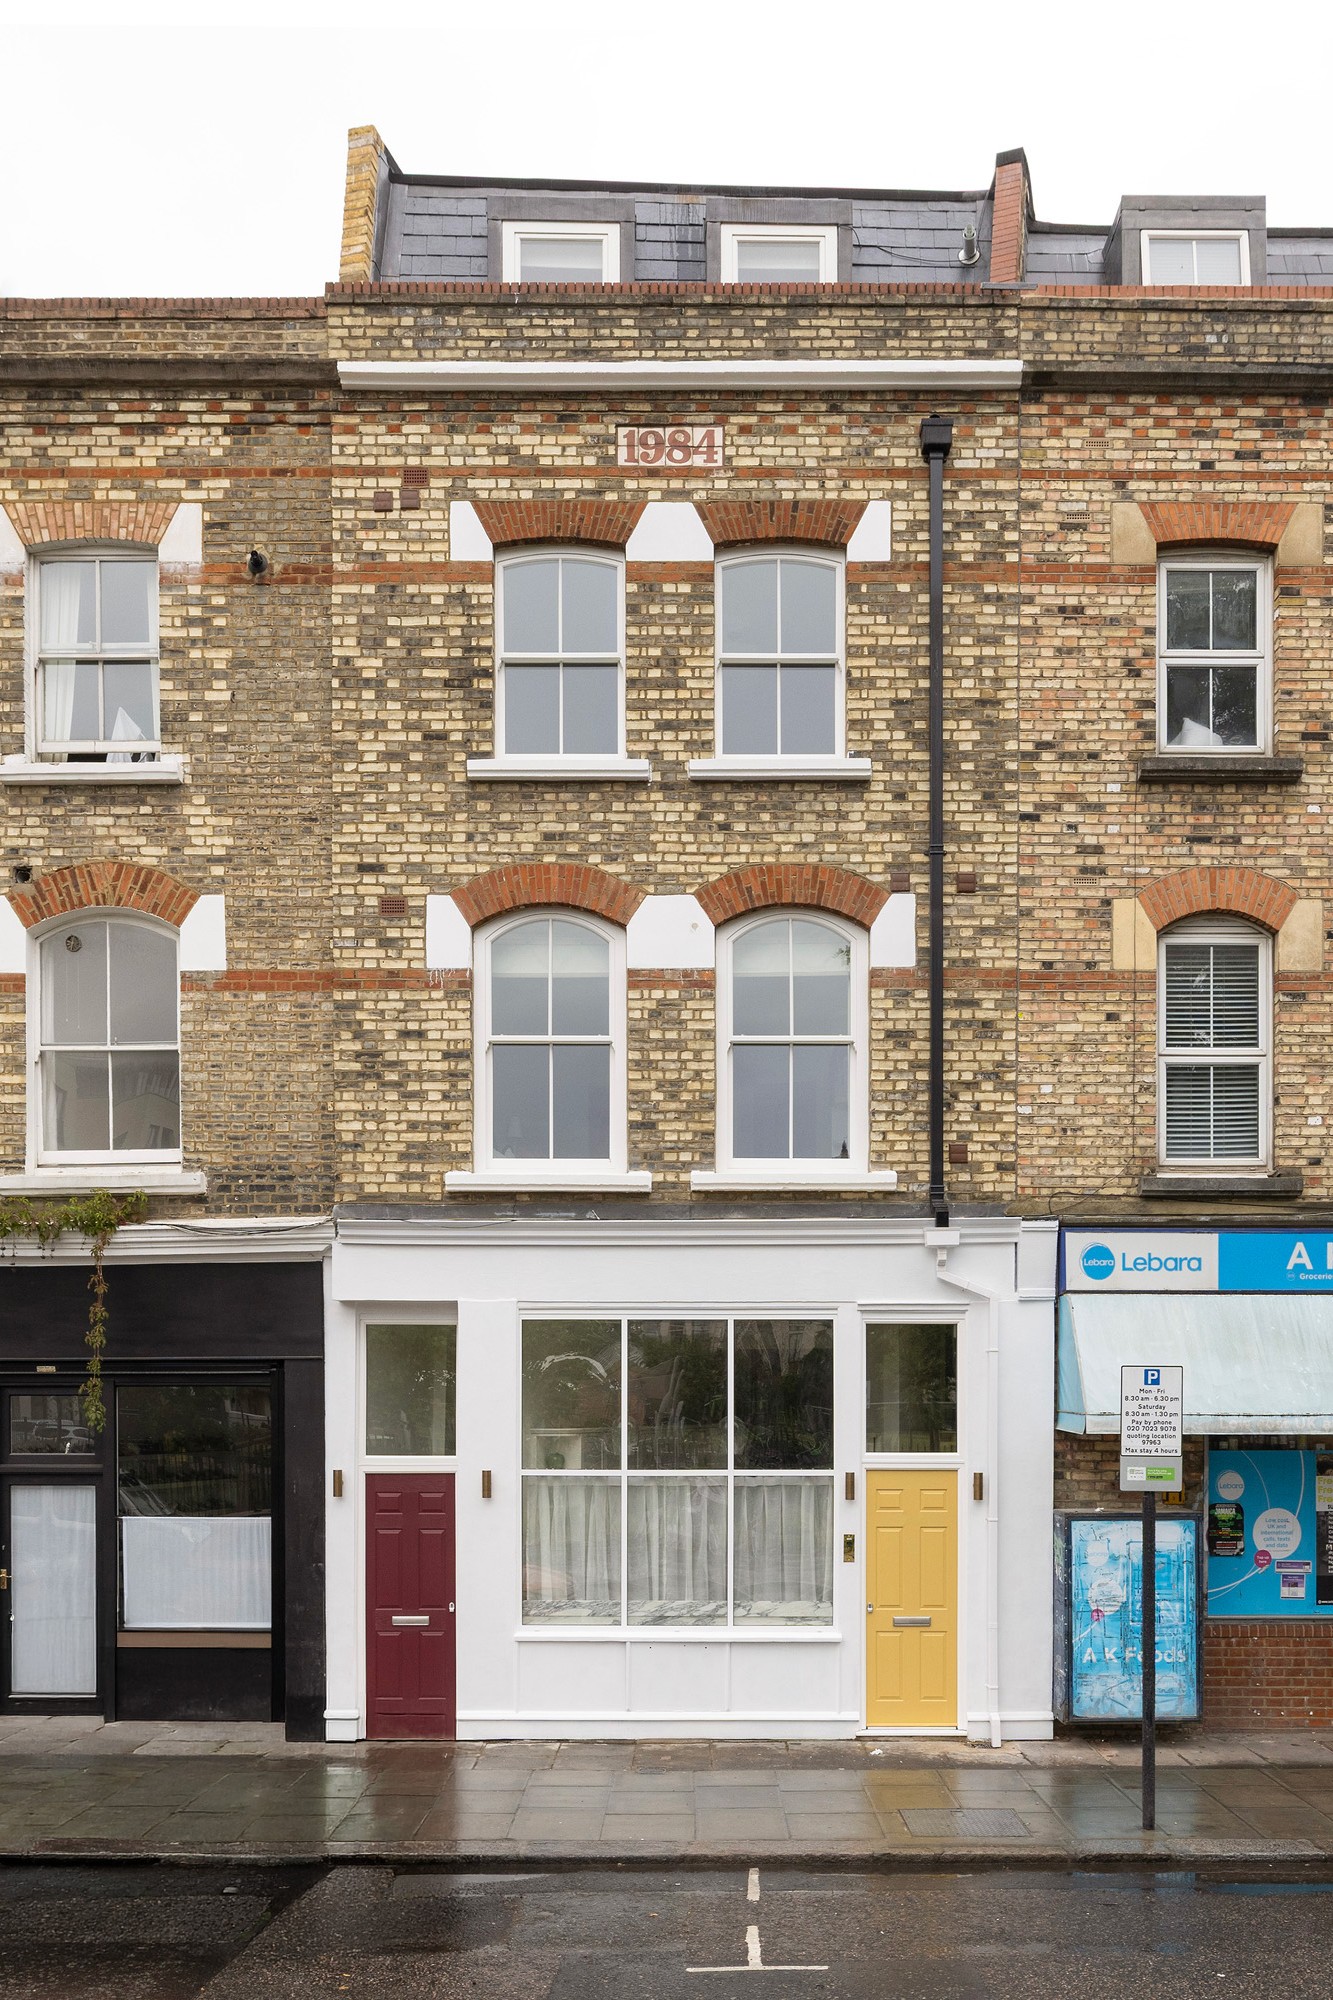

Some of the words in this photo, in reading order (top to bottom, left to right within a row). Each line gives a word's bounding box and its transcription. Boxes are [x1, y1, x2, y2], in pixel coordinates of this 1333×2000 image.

[622, 429, 718, 464] 1984
[1083, 1258, 1114, 1267] Lebara
[1121, 1252, 1202, 1272] Lebara
[1286, 1241, 1313, 1270] A
[1299, 1272, 1333, 1280] Grocerie
[1147, 1370, 1158, 1384] P
[1137, 1403, 1166, 1411] Saturday
[1126, 1432, 1150, 1440] quoting
[1151, 1432, 1177, 1440] location
[1082, 1647, 1097, 1663] A
[1104, 1647, 1118, 1663] K
